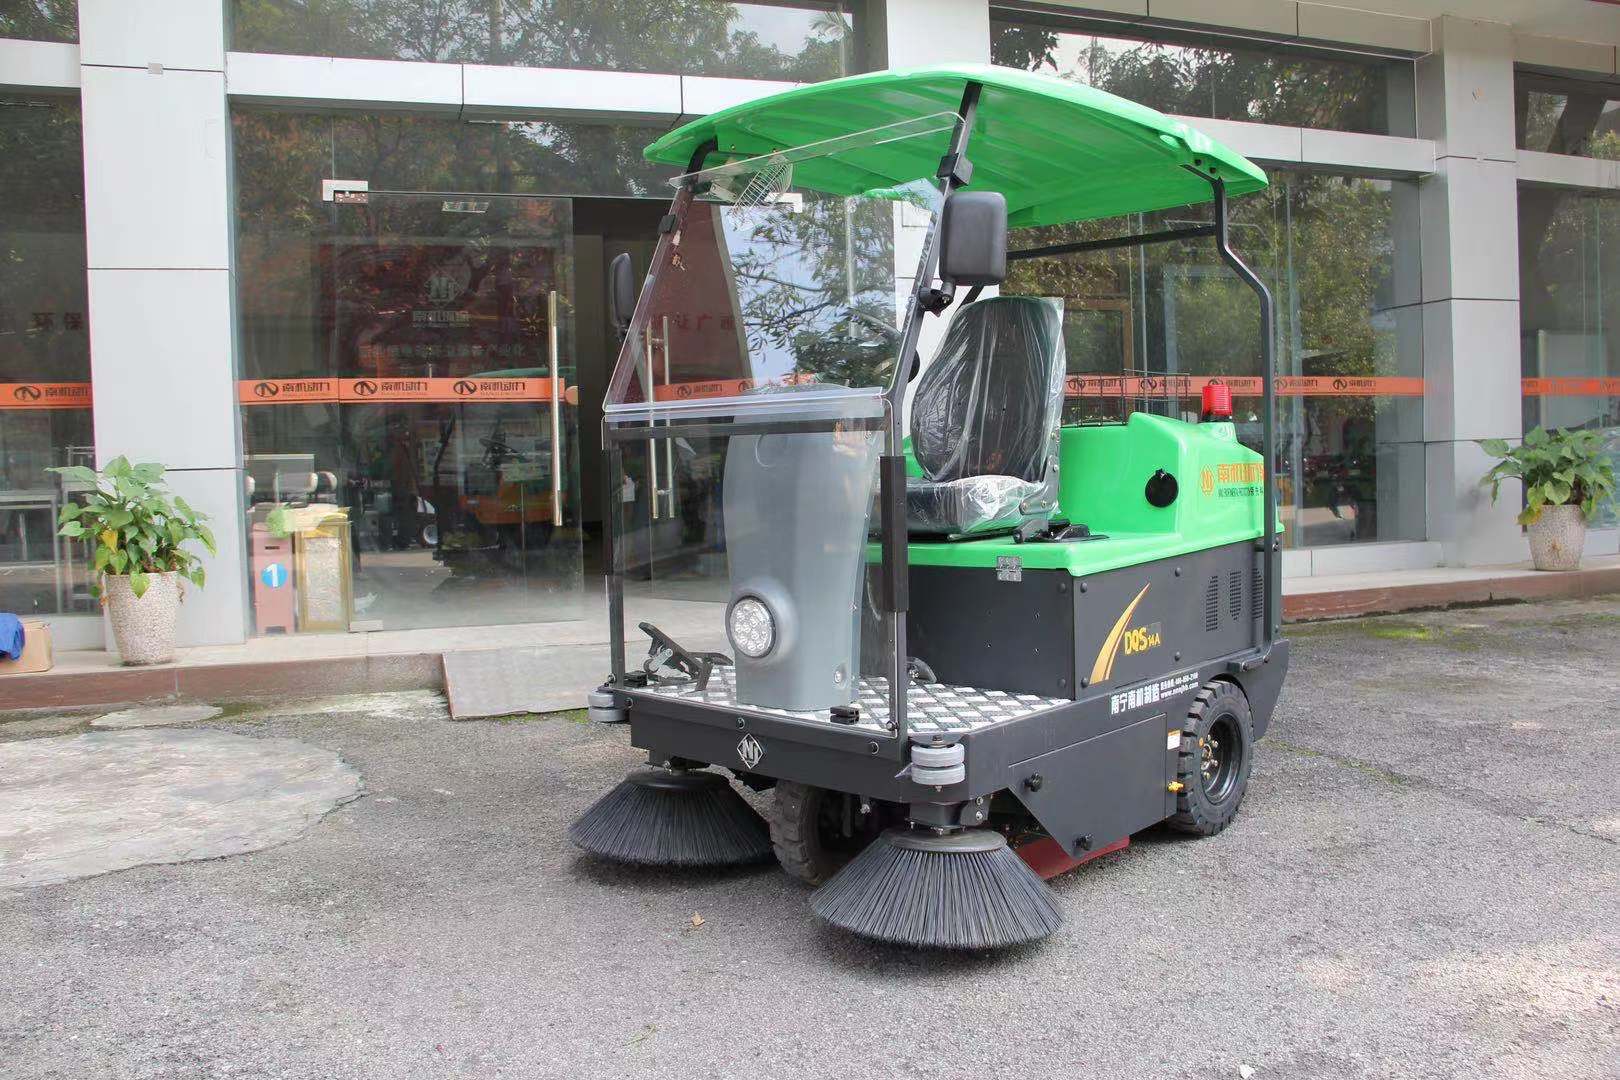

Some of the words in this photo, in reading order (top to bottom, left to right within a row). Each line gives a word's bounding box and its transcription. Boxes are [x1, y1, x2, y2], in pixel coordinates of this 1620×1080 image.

[263, 563, 279, 588] 1
[1110, 683, 1160, 715] 南宁南机制造
